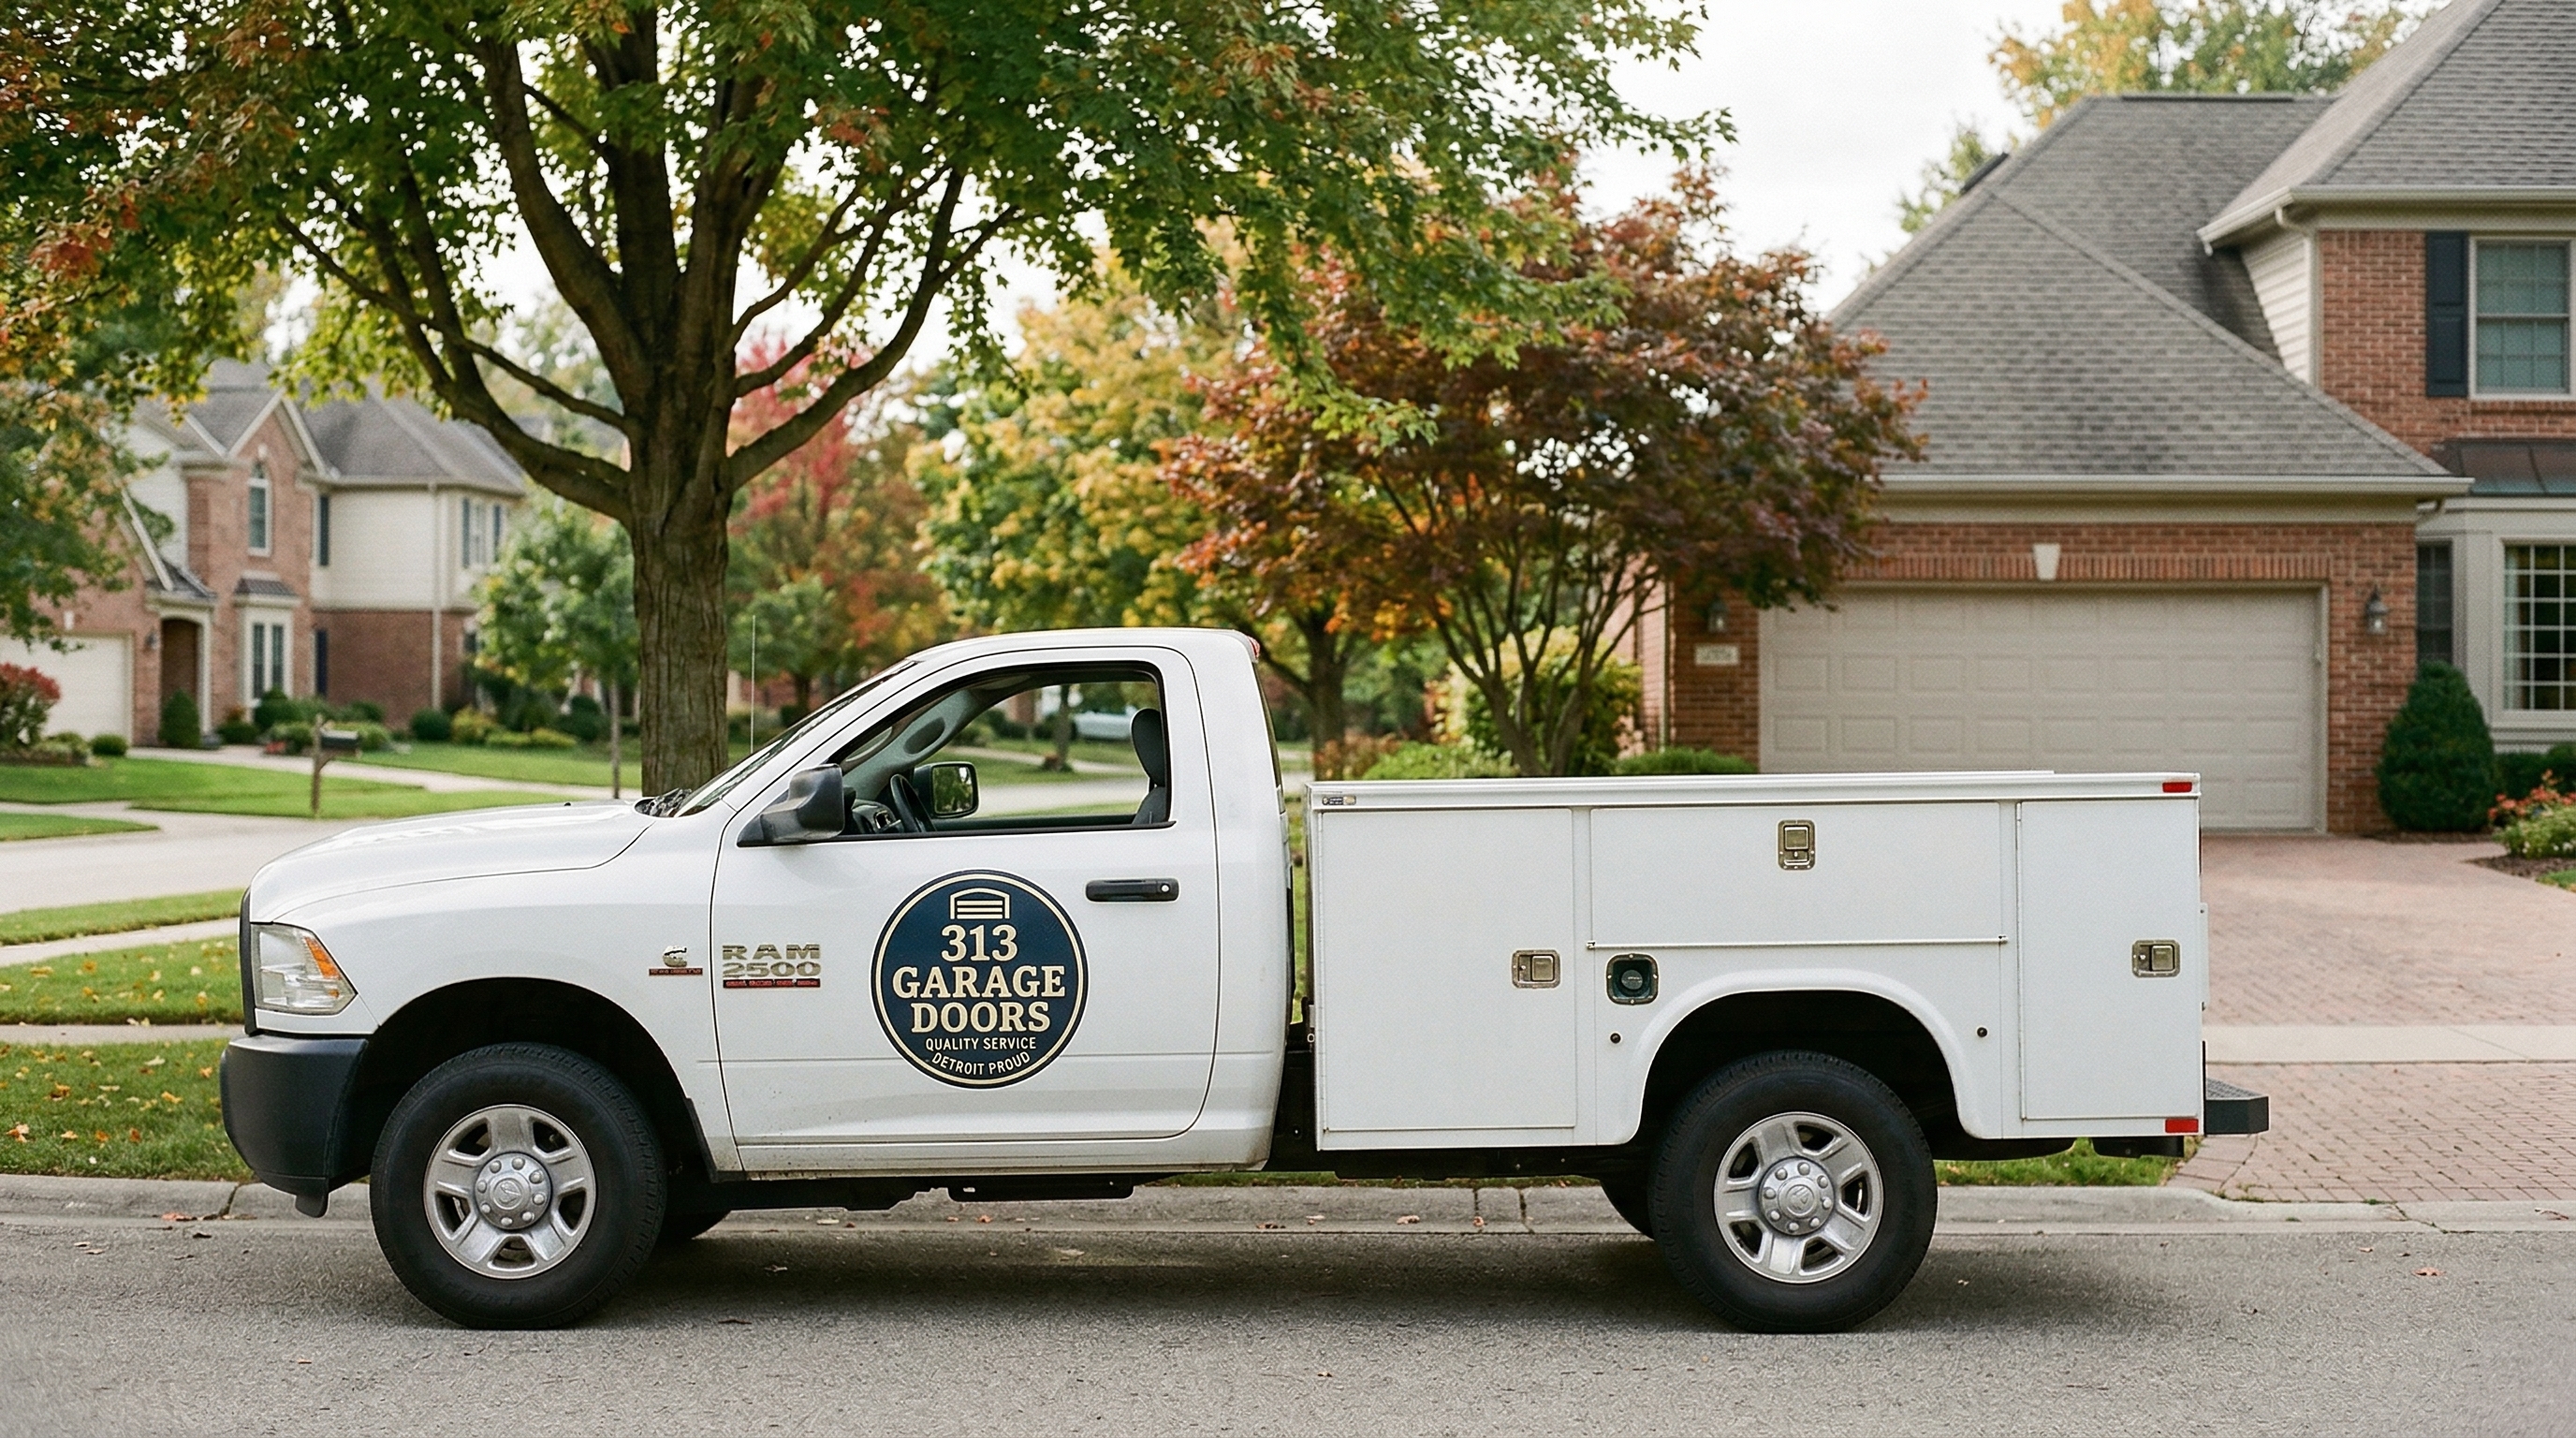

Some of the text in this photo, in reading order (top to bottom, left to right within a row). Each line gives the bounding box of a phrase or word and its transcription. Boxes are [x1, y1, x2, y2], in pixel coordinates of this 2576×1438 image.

[722, 944, 820, 960] RAM
[941, 924, 1018, 961] 313
[722, 961, 821, 978] 2500
[892, 965, 1065, 998] GARAGE
[911, 1002, 1050, 1033] DOORS
[926, 1036, 1036, 1051] QUALITY SERVICE
[931, 1050, 1031, 1076] DETROIT PROUD
